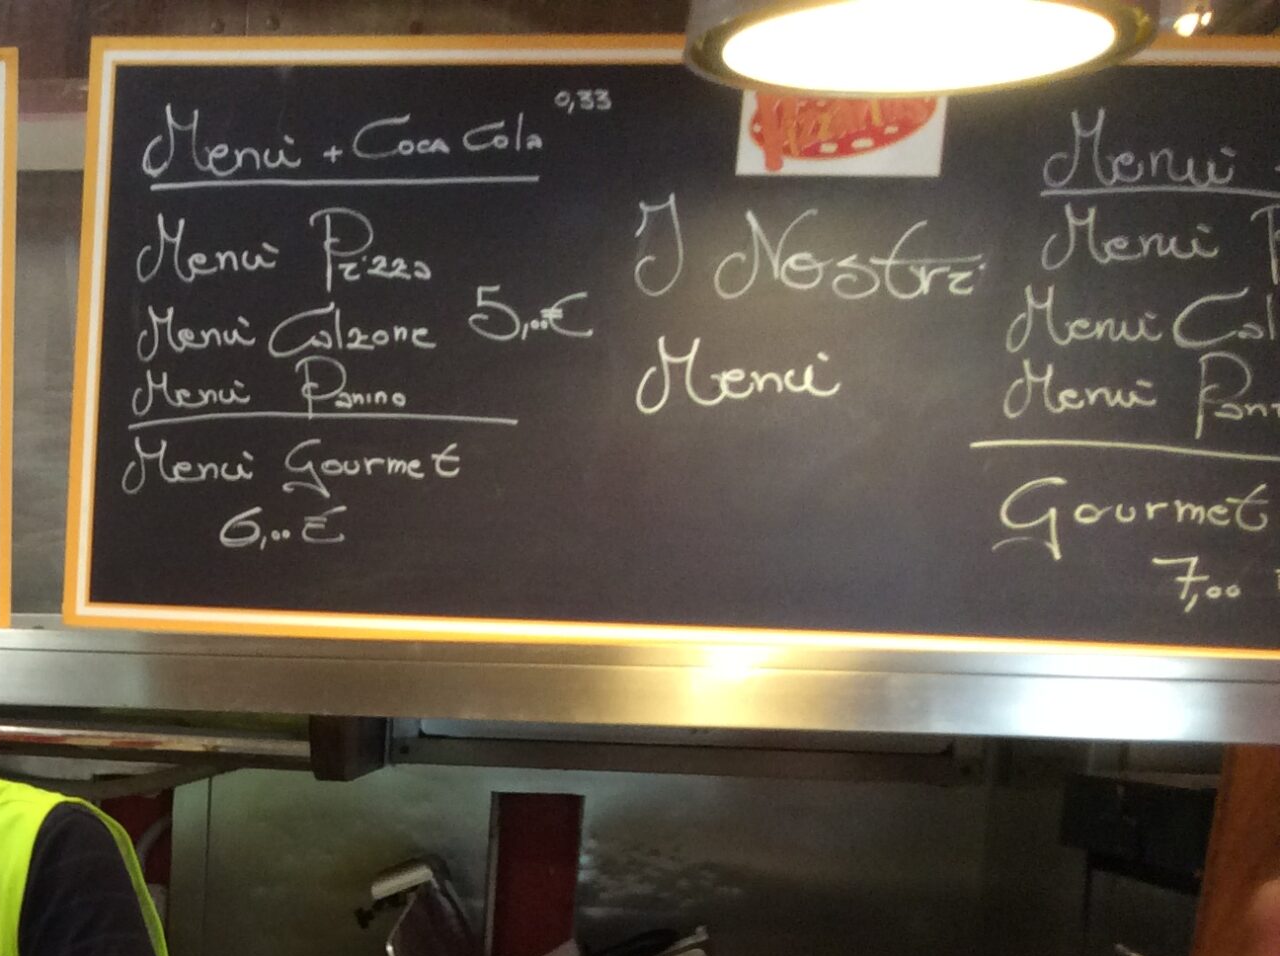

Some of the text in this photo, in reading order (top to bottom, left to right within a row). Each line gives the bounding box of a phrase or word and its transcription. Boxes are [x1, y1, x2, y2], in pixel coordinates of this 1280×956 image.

[323, 145, 344, 163] +
[352, 112, 451, 159] Coca
[462, 112, 544, 152] Cola
[554, 88, 613, 114] 0,33
[309, 206, 433, 294] Pizza
[714, 207, 986, 299] Nostri
[267, 300, 437, 358] Calzone
[295, 354, 407, 420] Panino
[282, 437, 461, 499] Gourmet
[991, 476, 1270, 562] Gourmet
